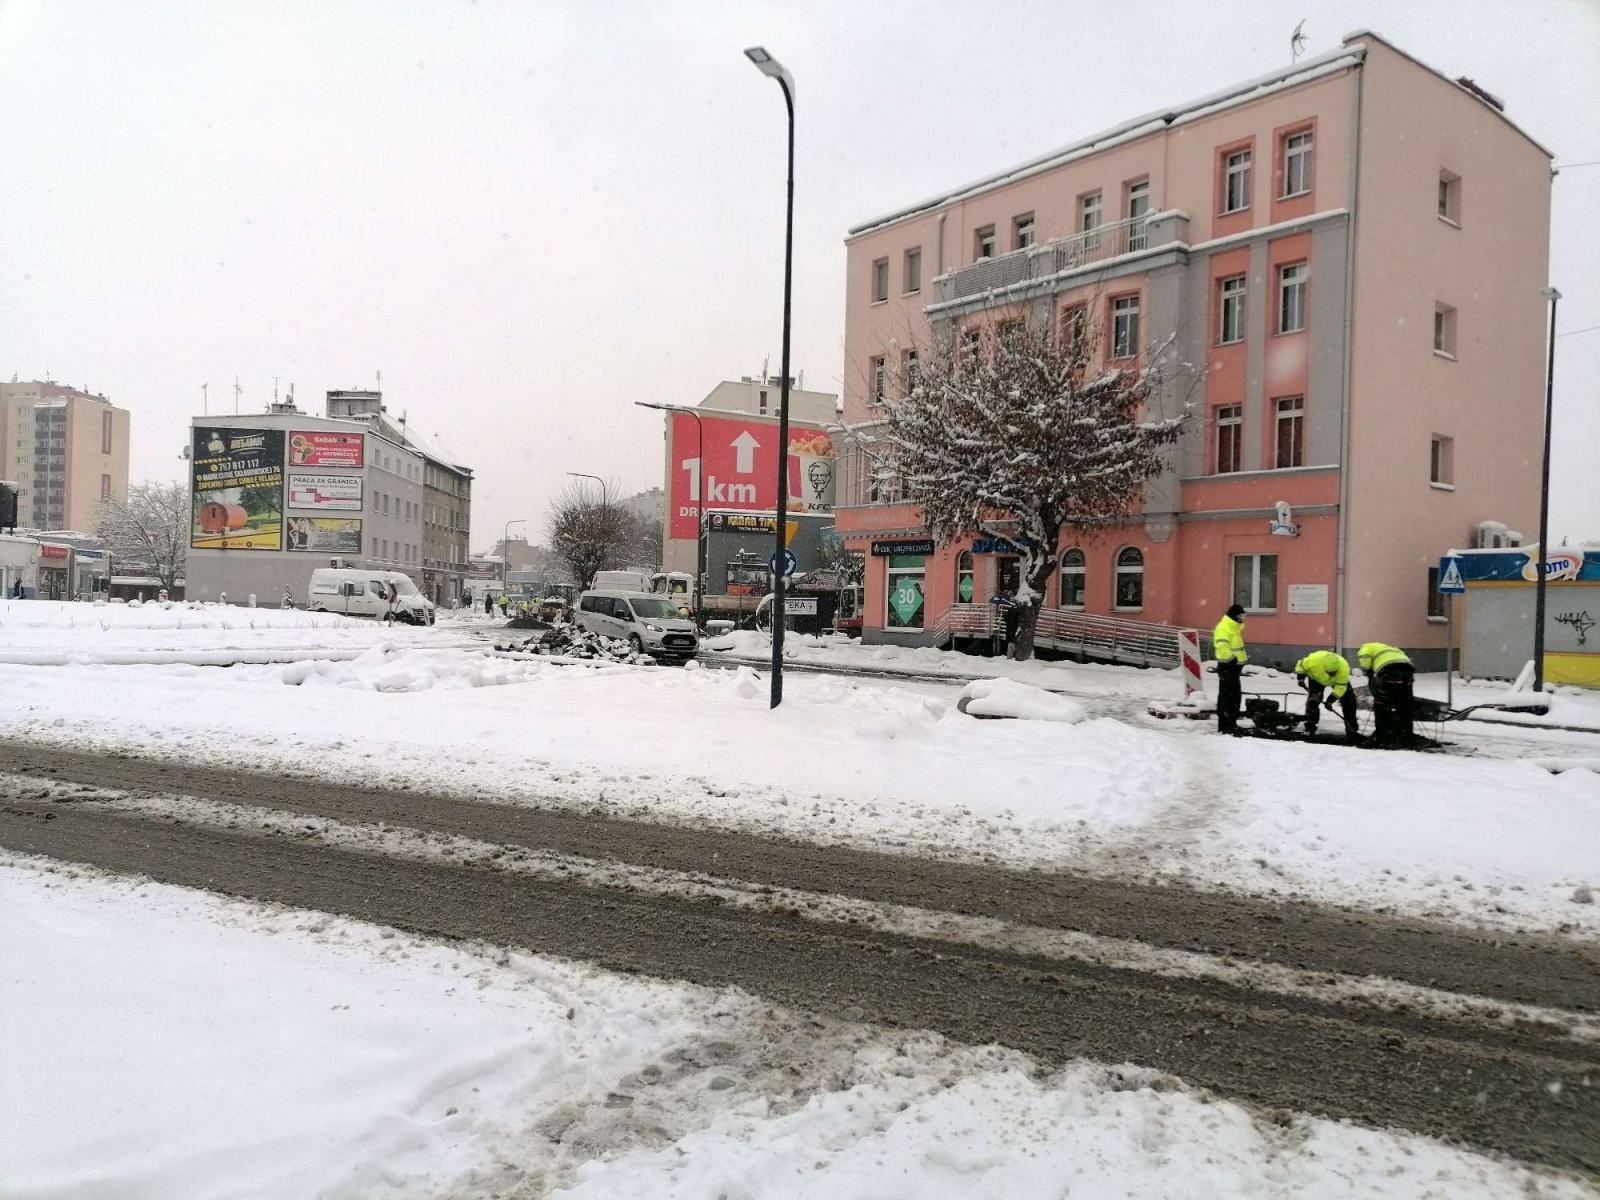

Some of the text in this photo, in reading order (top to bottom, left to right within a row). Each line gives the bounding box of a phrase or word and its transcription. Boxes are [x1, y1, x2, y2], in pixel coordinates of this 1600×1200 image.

[682, 457, 756, 503] 1 km
[807, 503, 831, 511] KFC
[728, 515, 757, 526] KEBAB
[1536, 559, 1569, 574] OTTO
[898, 588, 915, 604] 30
